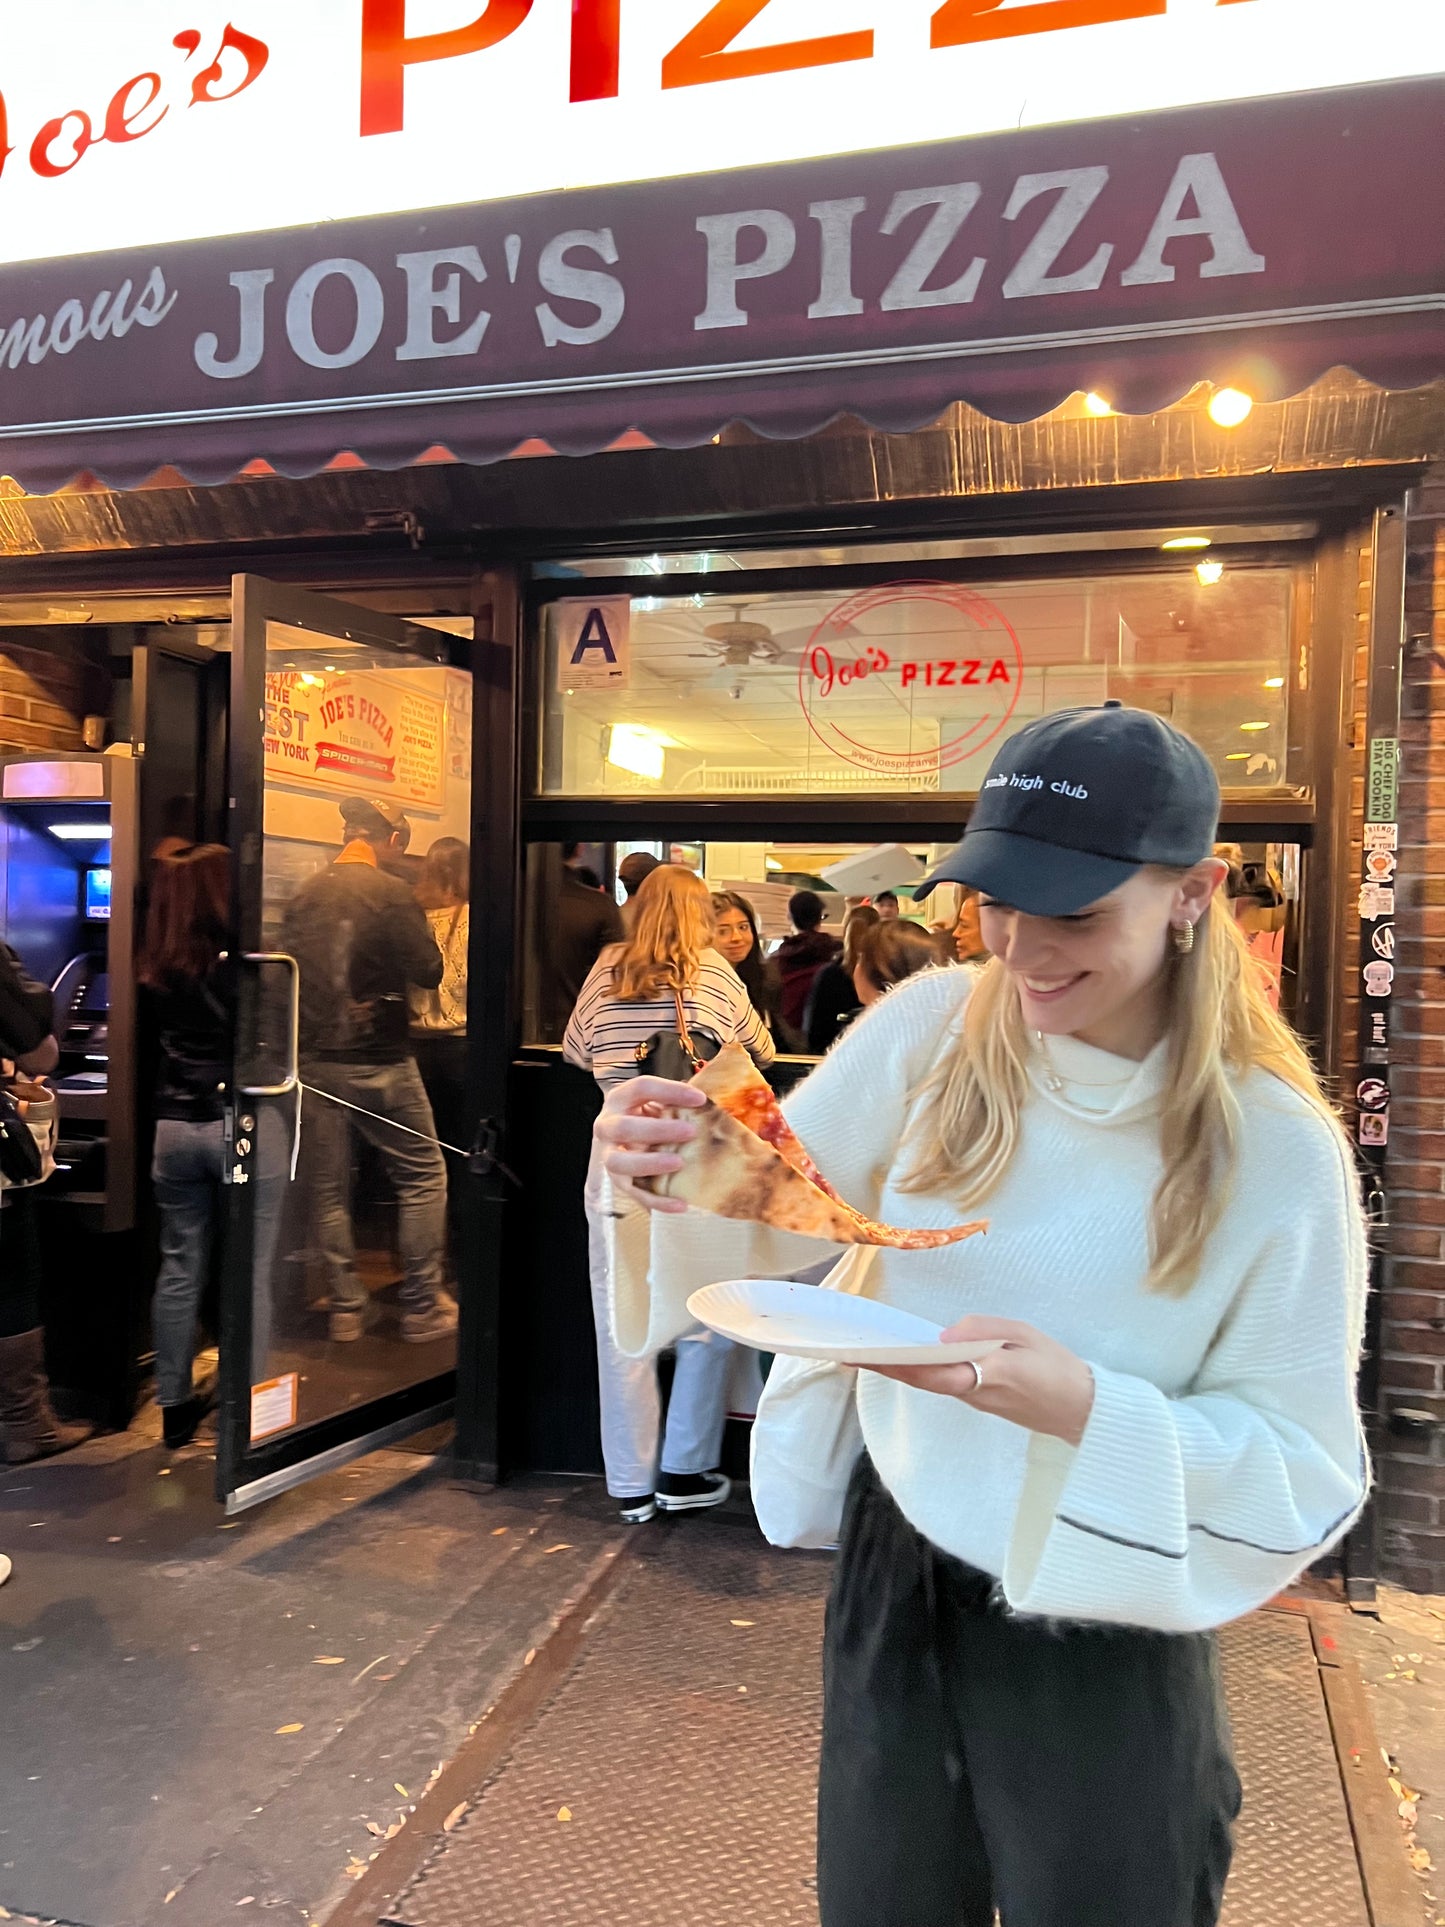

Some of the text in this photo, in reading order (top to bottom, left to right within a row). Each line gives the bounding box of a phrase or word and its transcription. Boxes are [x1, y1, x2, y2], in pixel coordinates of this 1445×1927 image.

[0, 22, 269, 179] oe's
[194, 227, 626, 379] JOE'S
[694, 152, 1266, 331] PIZZA
[570, 607, 618, 665] A
[810, 646, 1011, 698] Joe's PIZZA
[282, 740, 310, 761] YORK
[320, 694, 355, 730] JOE'S
[359, 696, 394, 749] PIZZA
[1009, 772, 1044, 791] high
[1050, 780, 1089, 799] club
[1371, 741, 1384, 816] STAY COOKIN
[1382, 741, 1394, 819] BIG CHEF DOG
